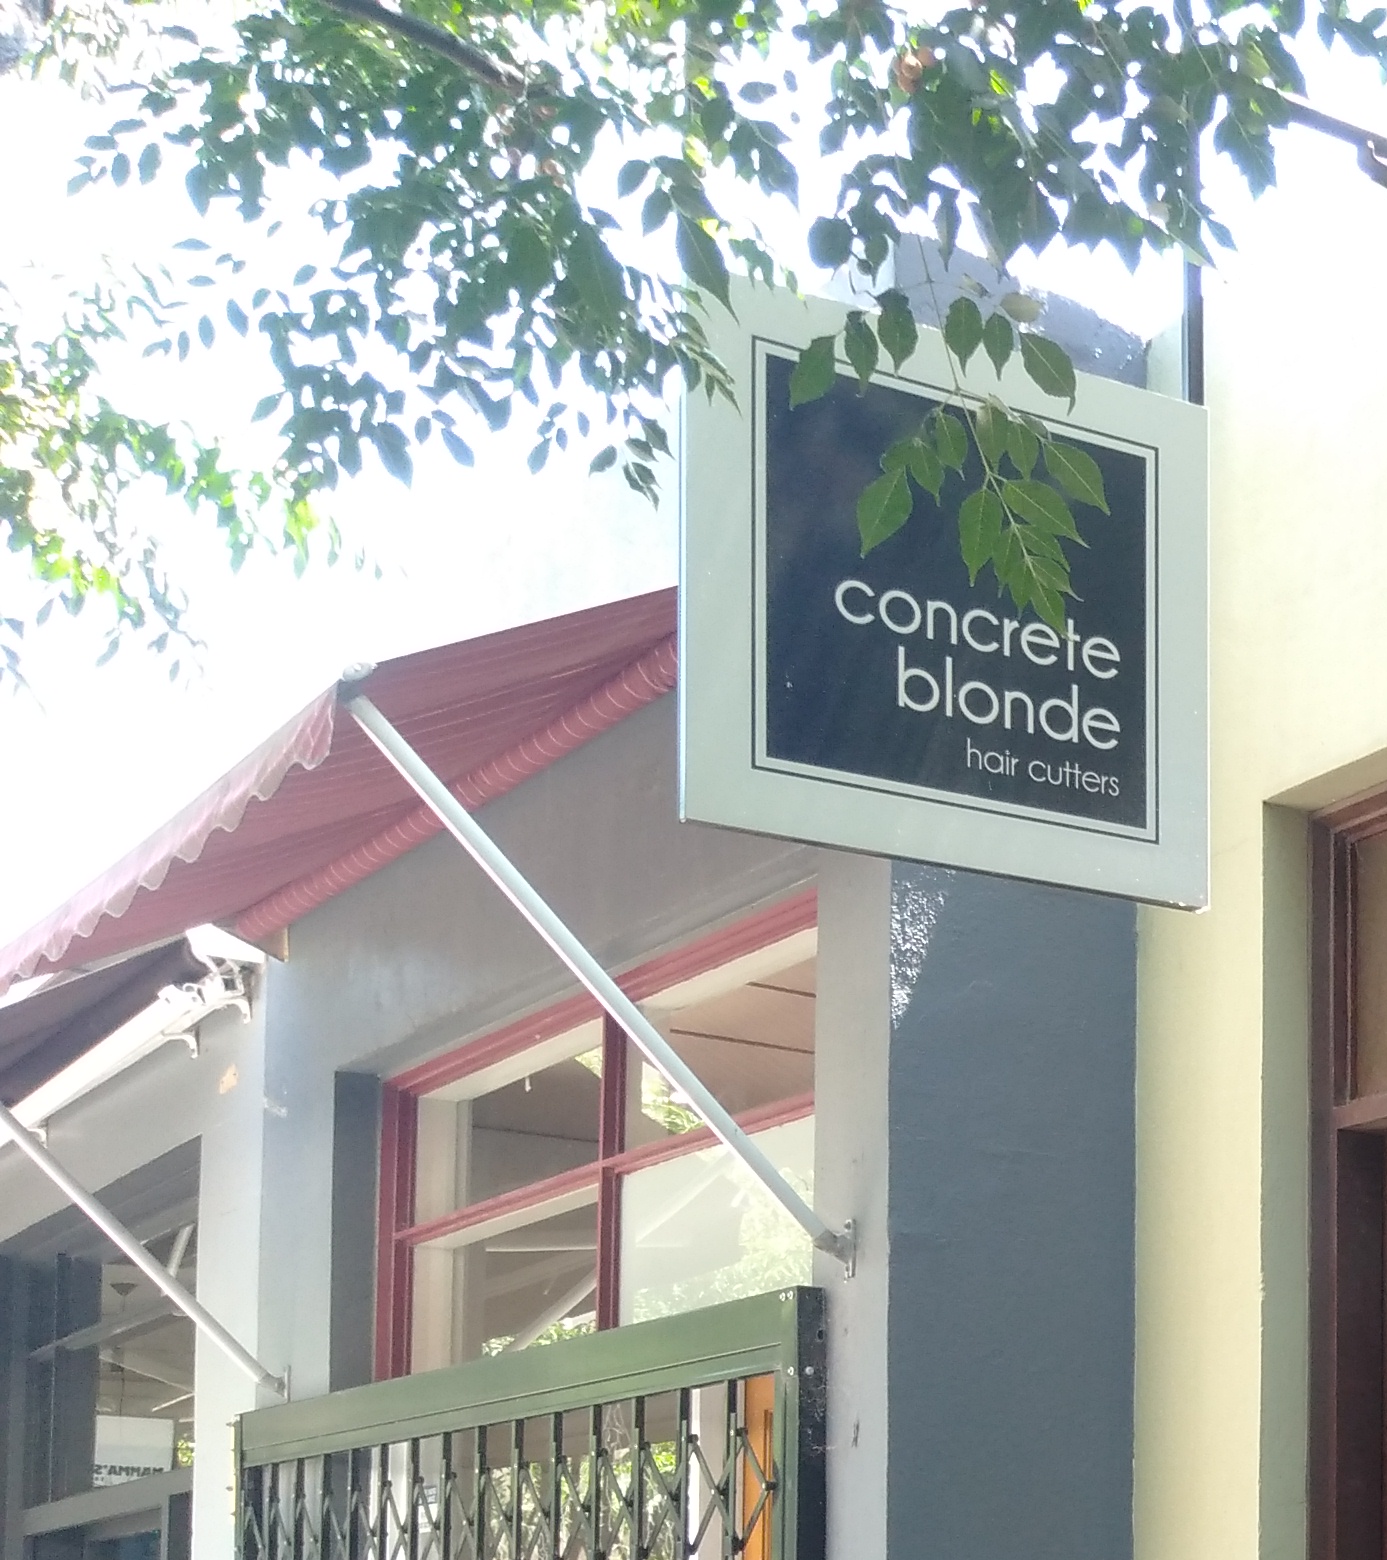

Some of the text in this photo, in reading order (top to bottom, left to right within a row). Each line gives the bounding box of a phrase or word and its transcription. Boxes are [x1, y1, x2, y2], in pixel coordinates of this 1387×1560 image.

[835, 580, 1120, 679] concrete
[898, 646, 1120, 749] blonde
[967, 738, 1119, 796] hair cutters
